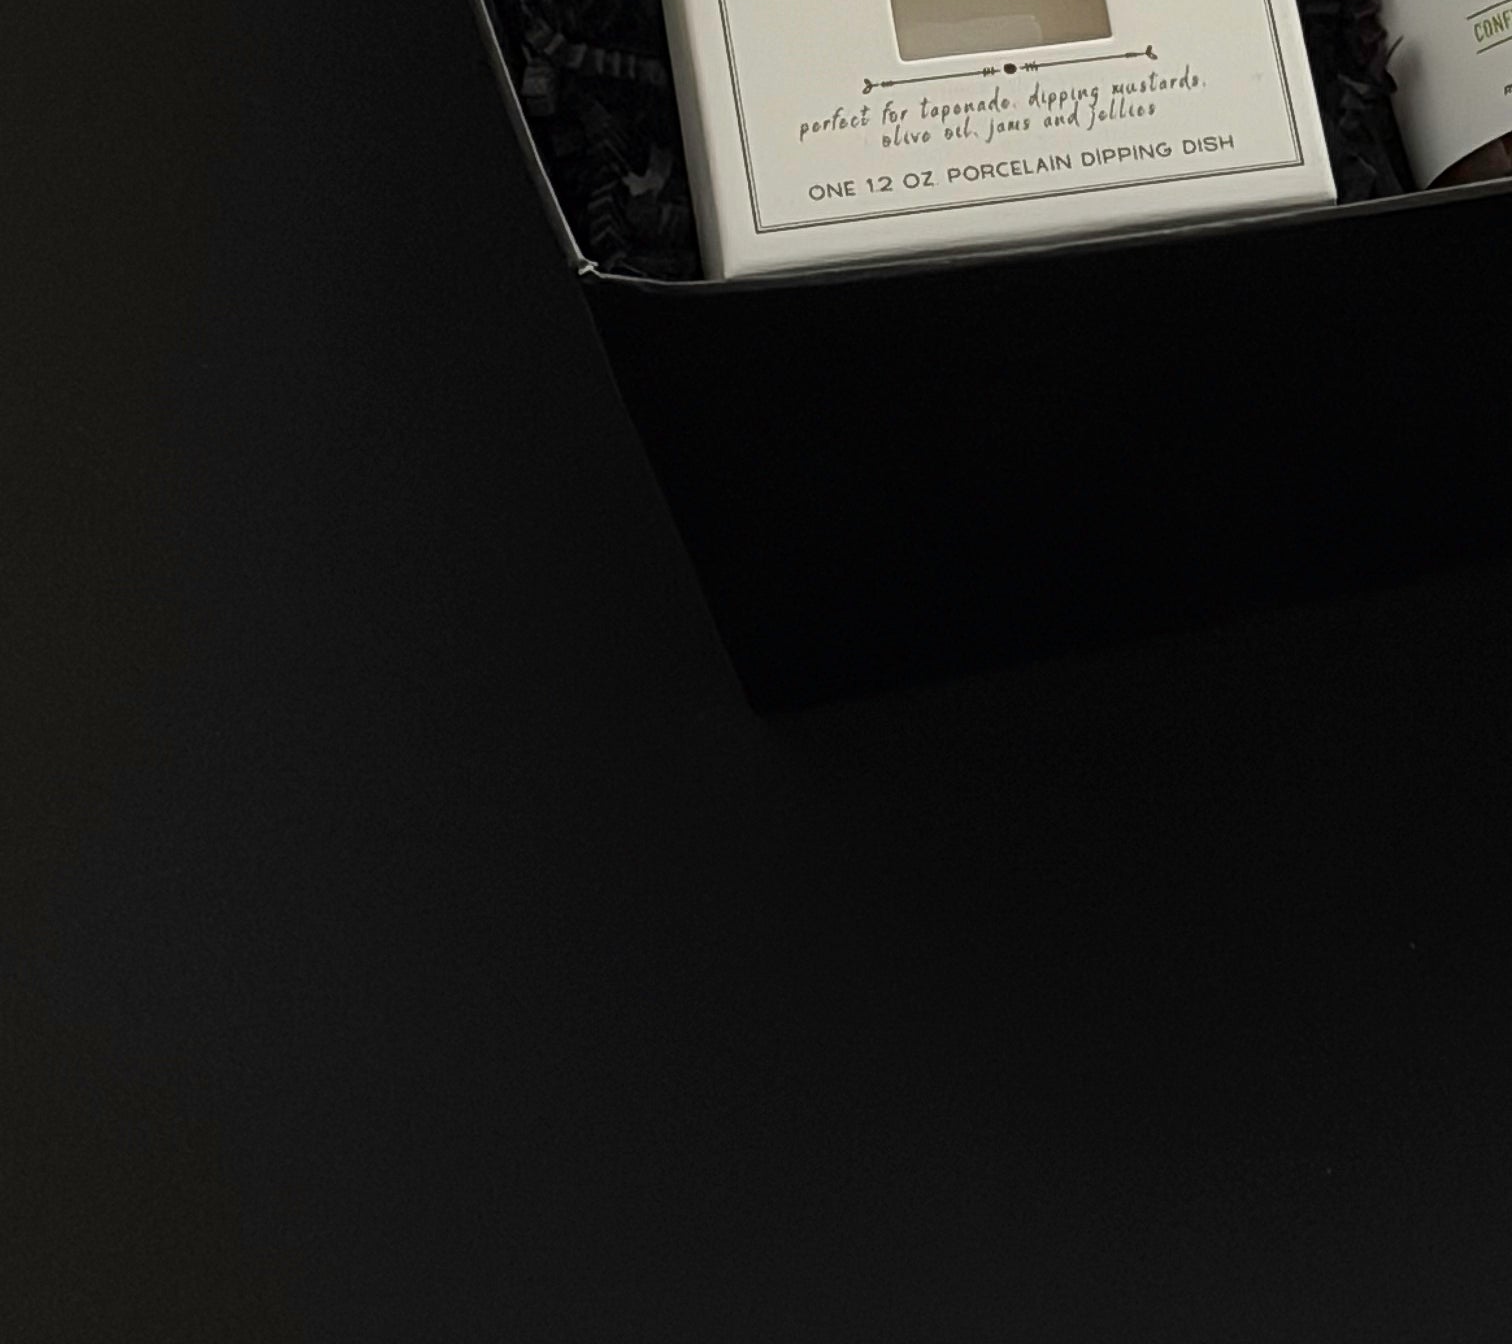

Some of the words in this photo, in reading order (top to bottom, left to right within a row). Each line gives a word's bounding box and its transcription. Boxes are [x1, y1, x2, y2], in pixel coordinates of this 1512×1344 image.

[800, 105, 870, 141] perfect
[882, 100, 908, 125] for
[1028, 81, 1099, 111] dipping
[882, 124, 931, 148] olive
[985, 116, 1031, 144] jams
[1043, 101, 1080, 129] and
[1087, 97, 1156, 131] jellies
[808, 180, 856, 201] ONE
[947, 154, 1072, 184] PORCELAIN
[1082, 141, 1172, 168] DIPPING
[1182, 134, 1235, 156] DISH
